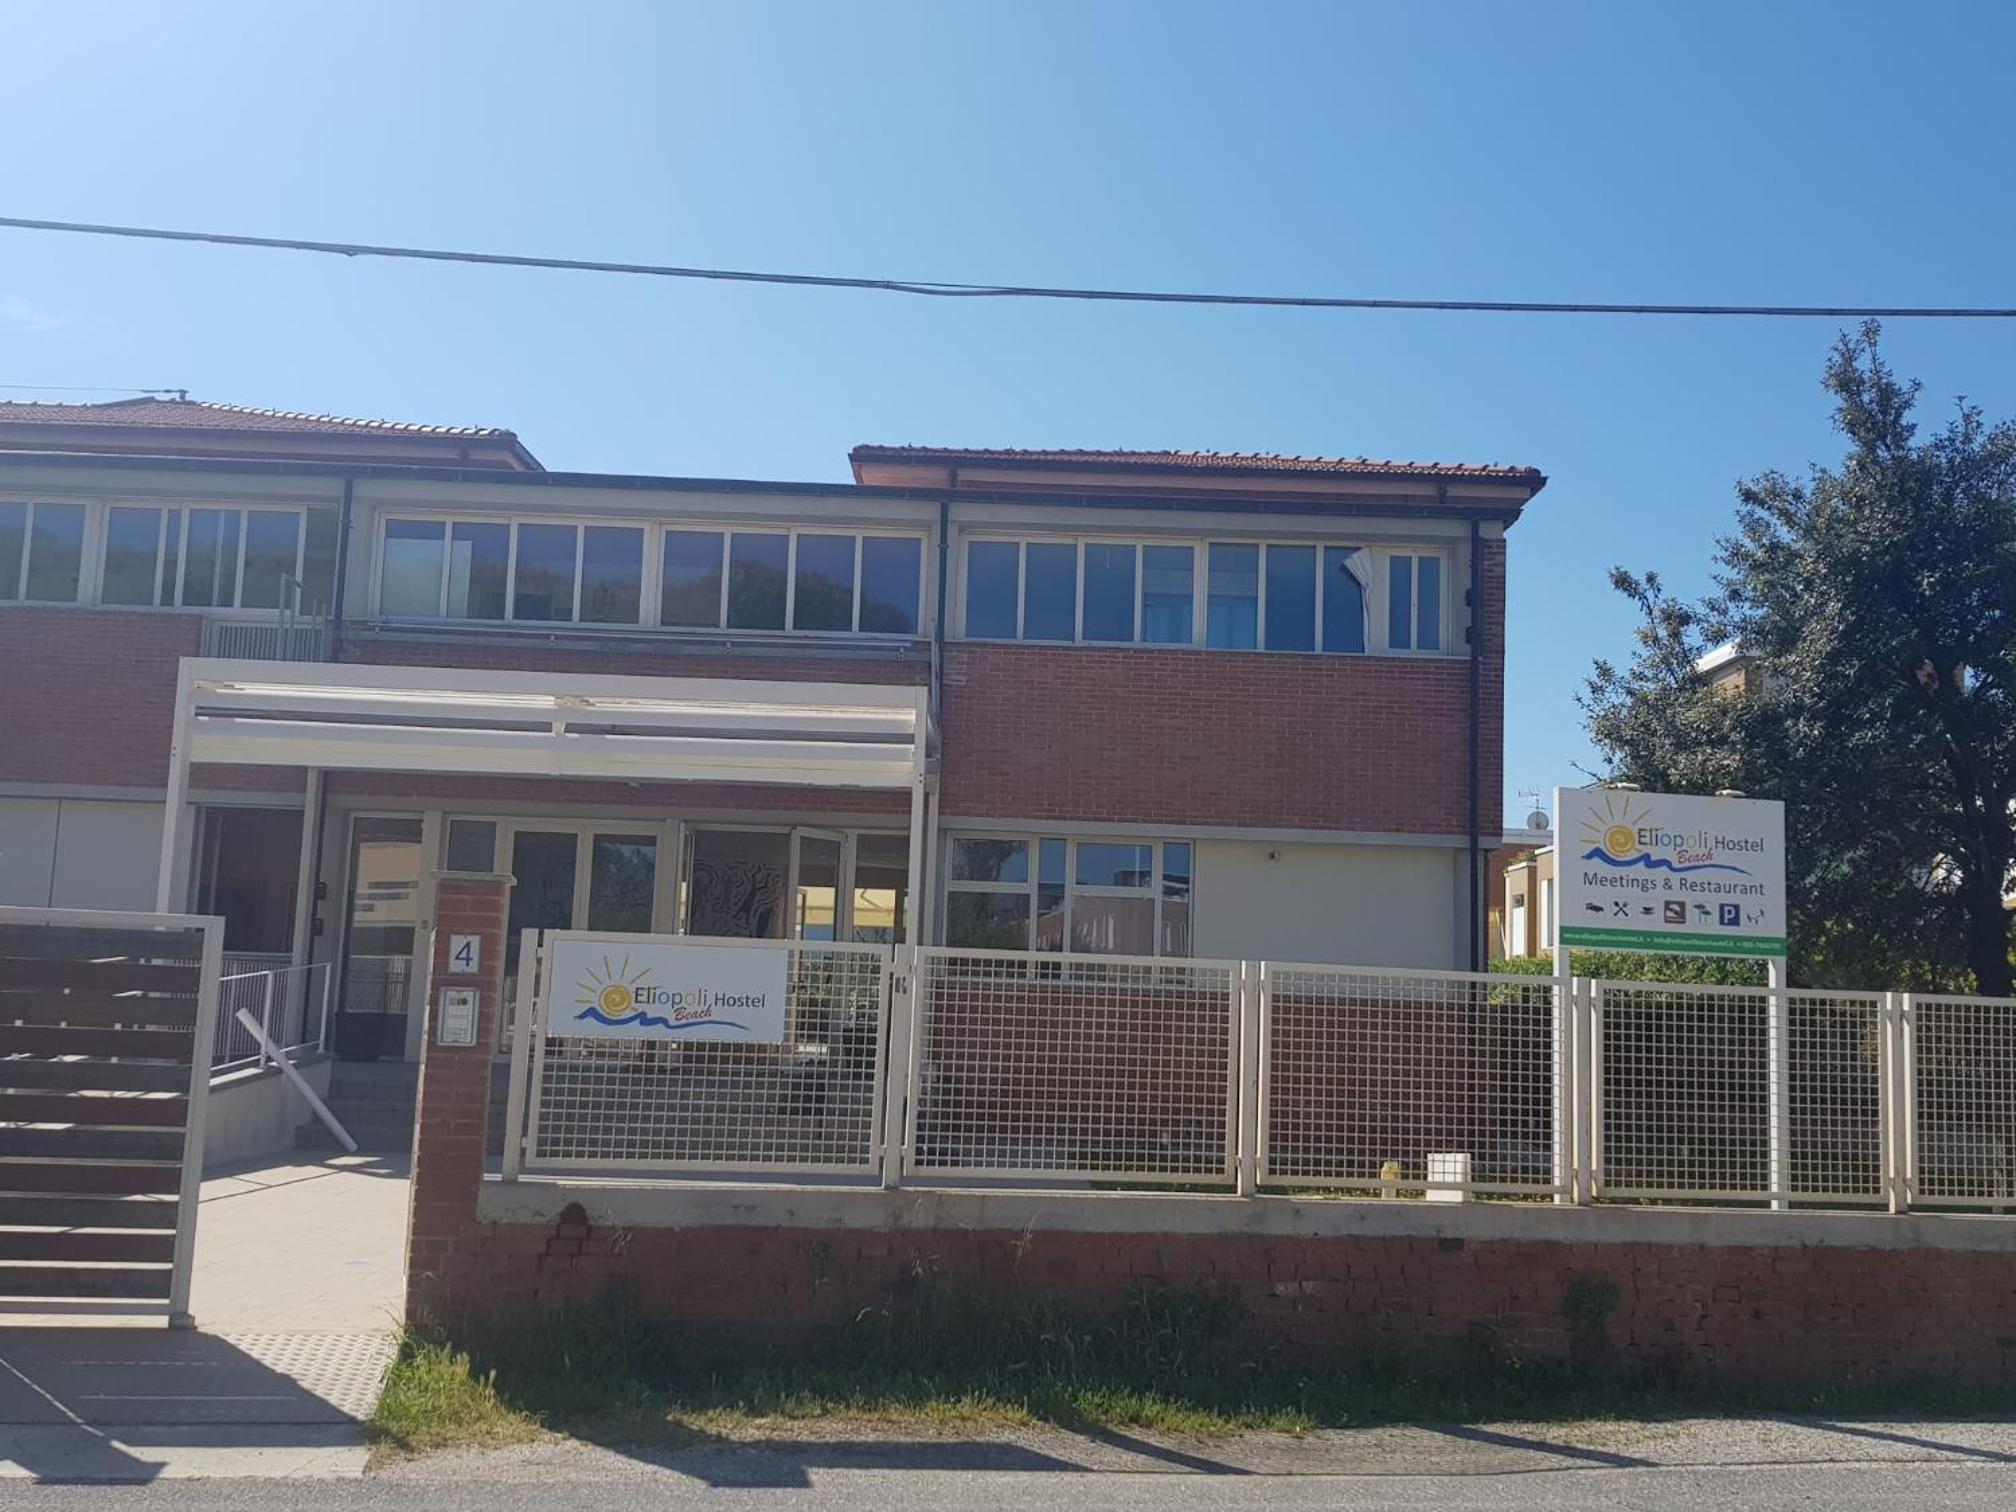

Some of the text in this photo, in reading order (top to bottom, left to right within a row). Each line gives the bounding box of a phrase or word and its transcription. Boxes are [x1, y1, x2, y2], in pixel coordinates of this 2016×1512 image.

[1637, 827, 1764, 852] Eliopoli Hostel
[1676, 847, 1714, 865] Beach
[1583, 872, 1765, 896] Meetings & Restaurant
[454, 940, 474, 968] 4
[634, 986, 766, 1009] Eliopoli Hostel
[673, 1003, 713, 1021] Beach
